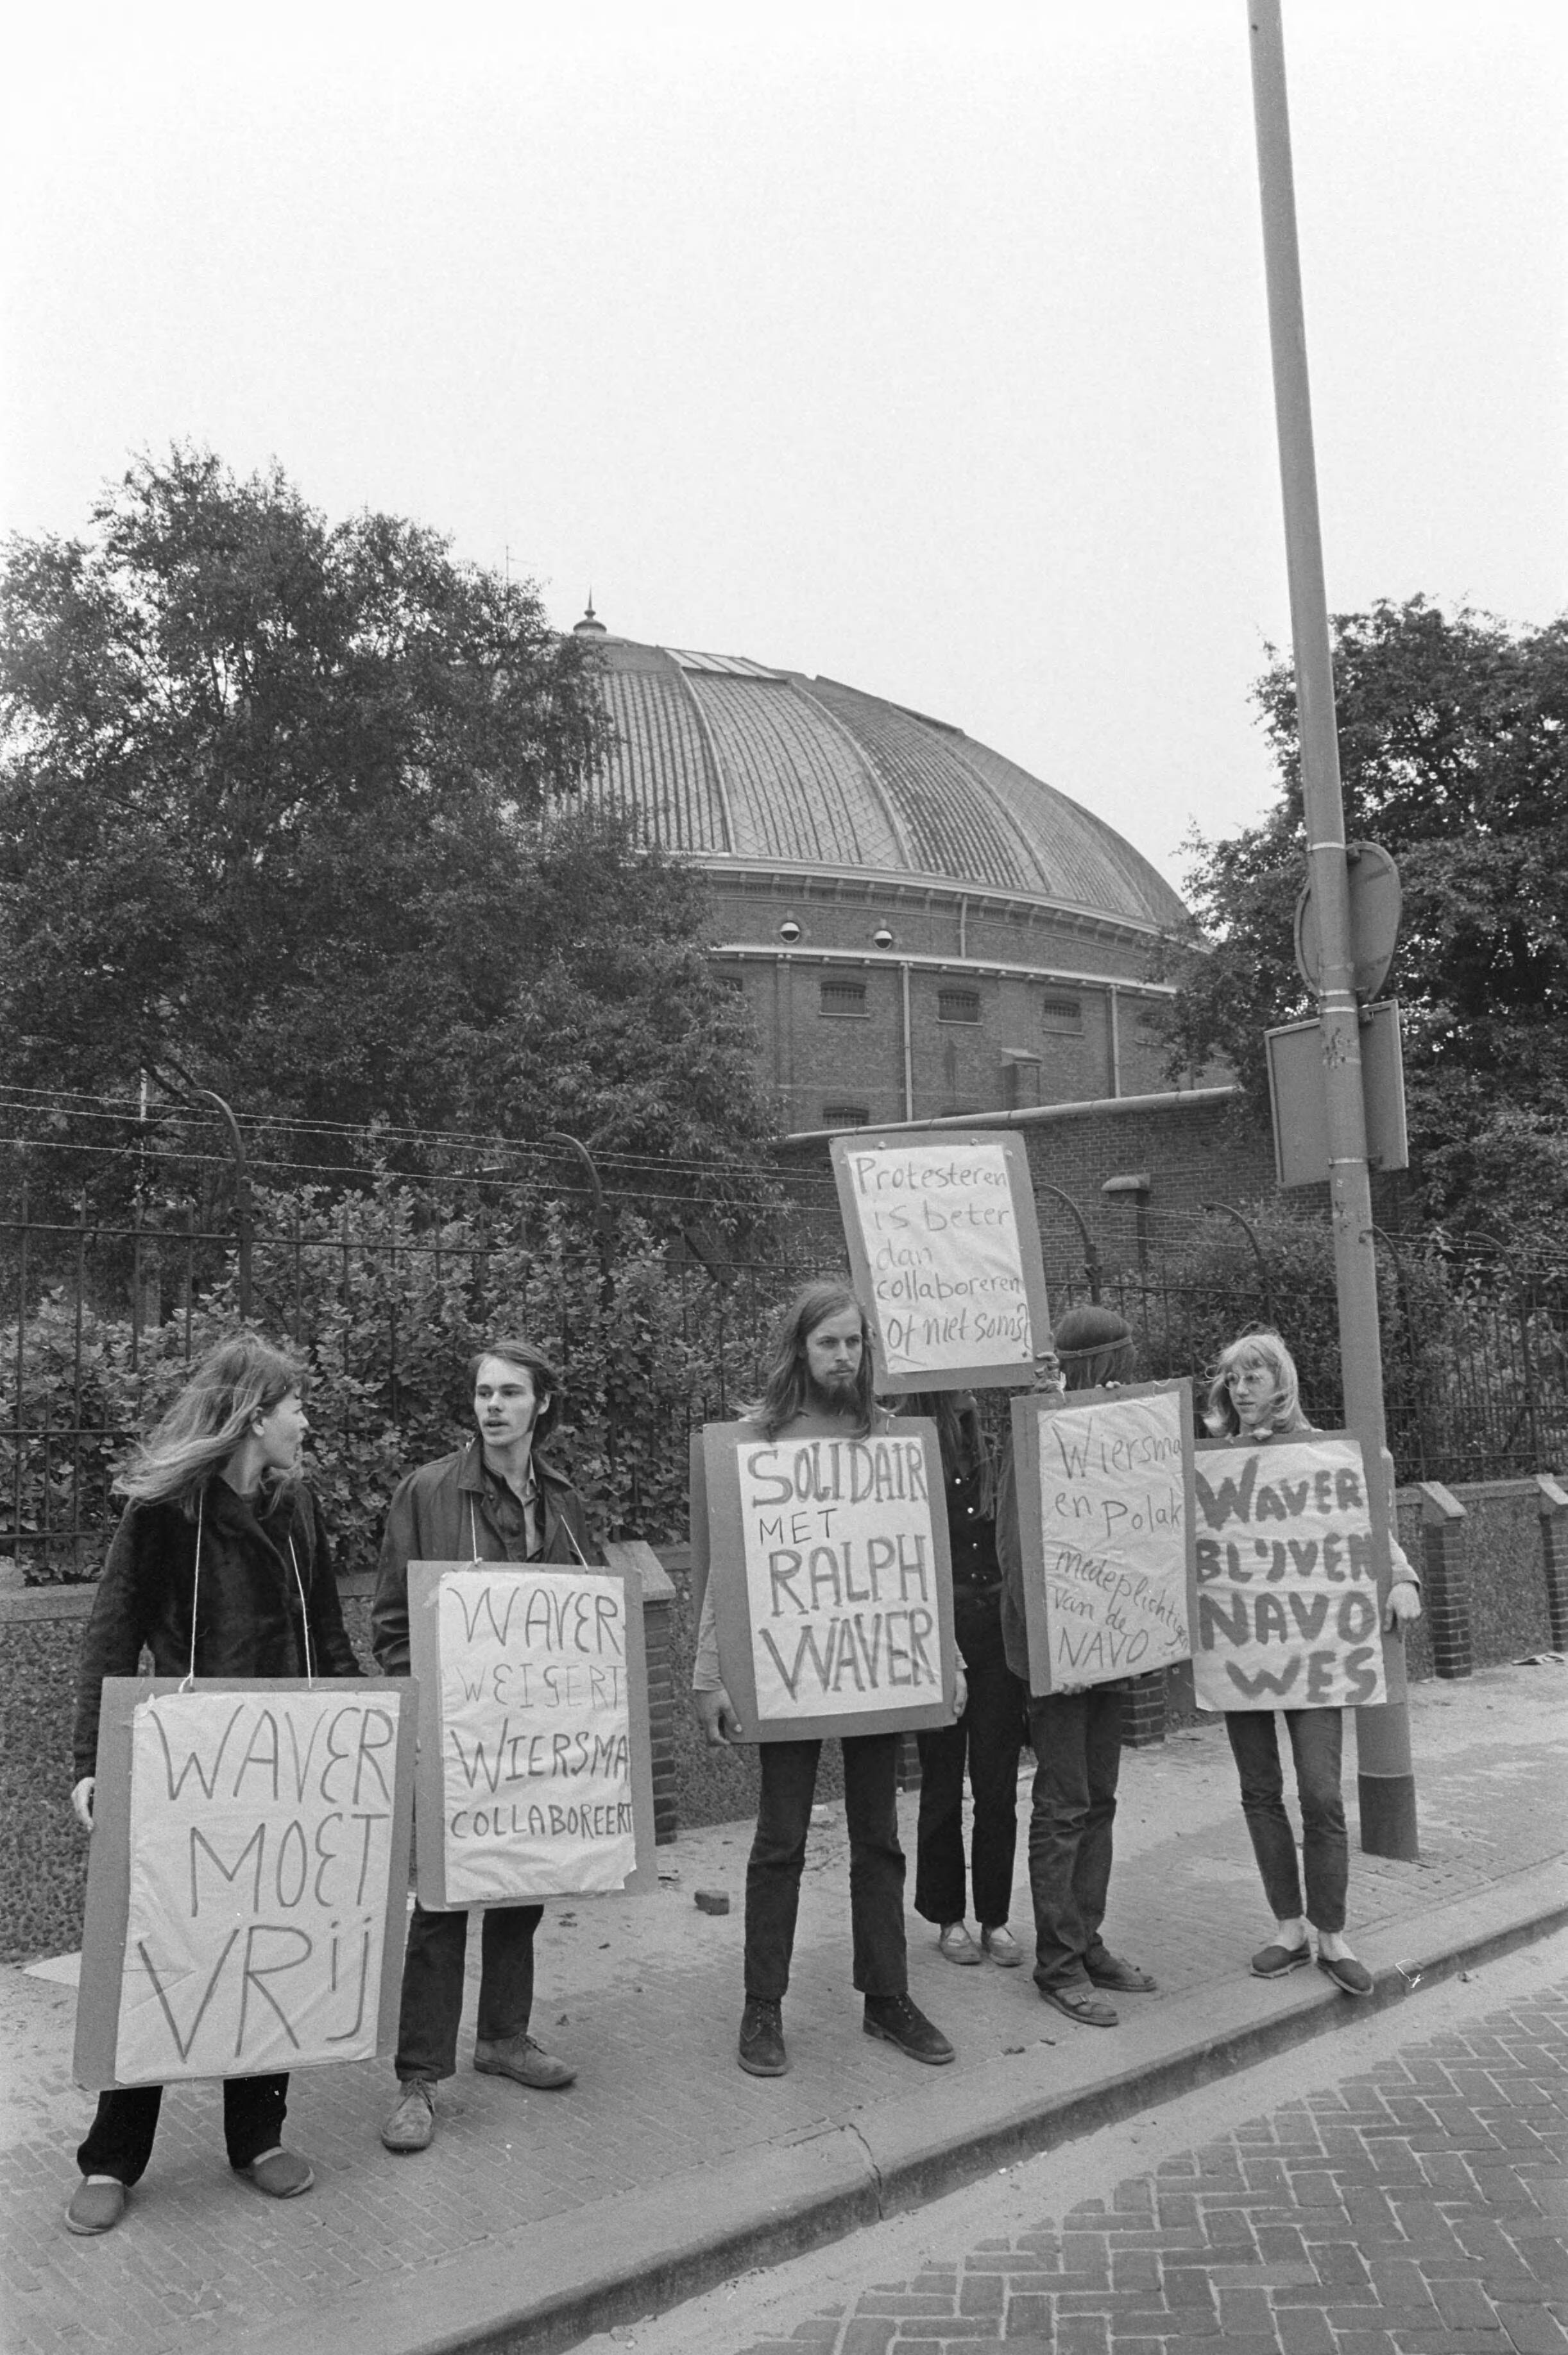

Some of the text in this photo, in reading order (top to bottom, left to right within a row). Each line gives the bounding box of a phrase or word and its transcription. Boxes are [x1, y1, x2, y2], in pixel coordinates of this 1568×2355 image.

[856, 1157, 1007, 1195] Protesteren
[874, 1199, 1012, 1231] is beter
[876, 1239, 933, 1270] dan
[877, 1270, 1021, 1302] collaboreren
[887, 1314, 916, 1356] Of
[923, 1307, 969, 1345] niet
[747, 1441, 928, 1508] SOLIDAIR
[1052, 1416, 1182, 1479] Wiersma
[1055, 1487, 1182, 1538] en Polak
[1195, 1454, 1363, 1531] WAVER
[759, 1508, 839, 1545] MET
[769, 1534, 928, 1617] RALPH
[446, 1586, 622, 1656] WAVER
[1058, 1627, 1149, 1668] NAVO
[1105, 1606, 1133, 1637] de
[1199, 1591, 1377, 1651] NAVO
[758, 1608, 936, 1703] WAVER
[1225, 1647, 1377, 1703] WES
[149, 1704, 391, 1805] WAVER
[450, 1717, 629, 1793] WIERSMA
[450, 1801, 632, 1839] COLLABOREERT
[191, 1812, 391, 1918] MOET
